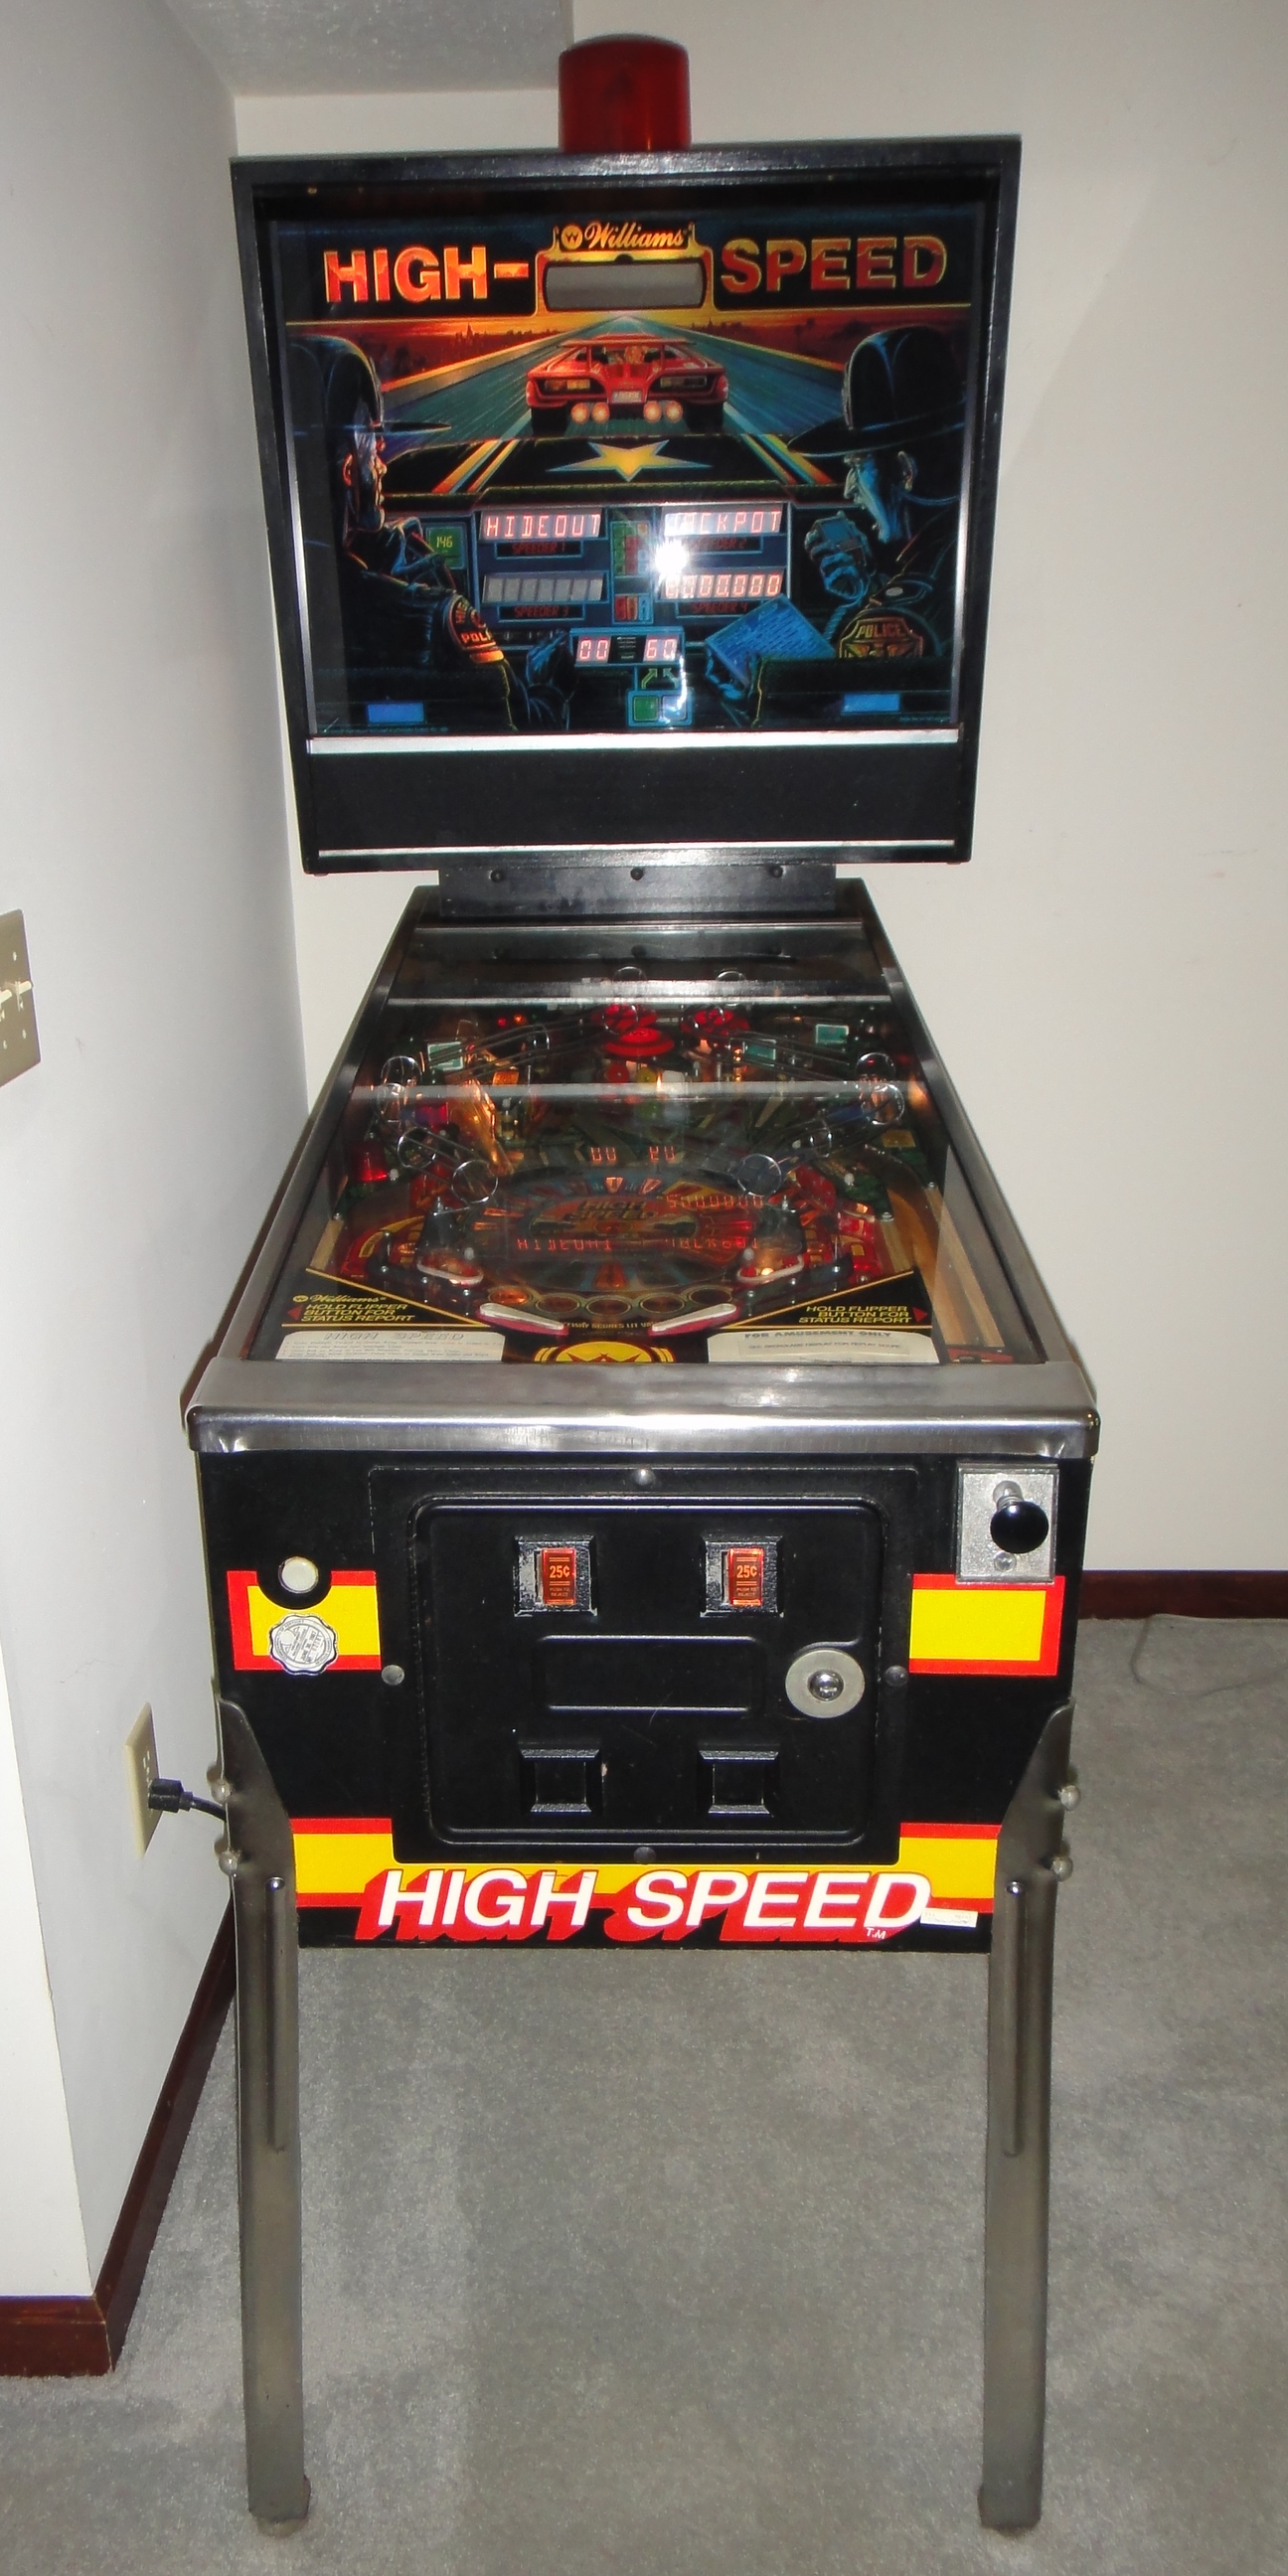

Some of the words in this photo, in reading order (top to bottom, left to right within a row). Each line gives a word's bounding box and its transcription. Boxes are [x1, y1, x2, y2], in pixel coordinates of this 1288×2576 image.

[584, 222, 685, 248] Williams
[721, 236, 948, 293] SPEED
[486, 513, 601, 538] HIDEOUT
[855, 622, 902, 639] POLICE
[579, 639, 609, 660] 00
[646, 638, 676, 659] 60
[309, 1294, 381, 1304] Williams
[323, 1332, 380, 1341] HIGH
[549, 1564, 570, 1578] 25¢
[736, 1564, 758, 1578] 25¢
[378, 1869, 598, 1927] HIGH
[627, 1870, 932, 1928] SPEED
